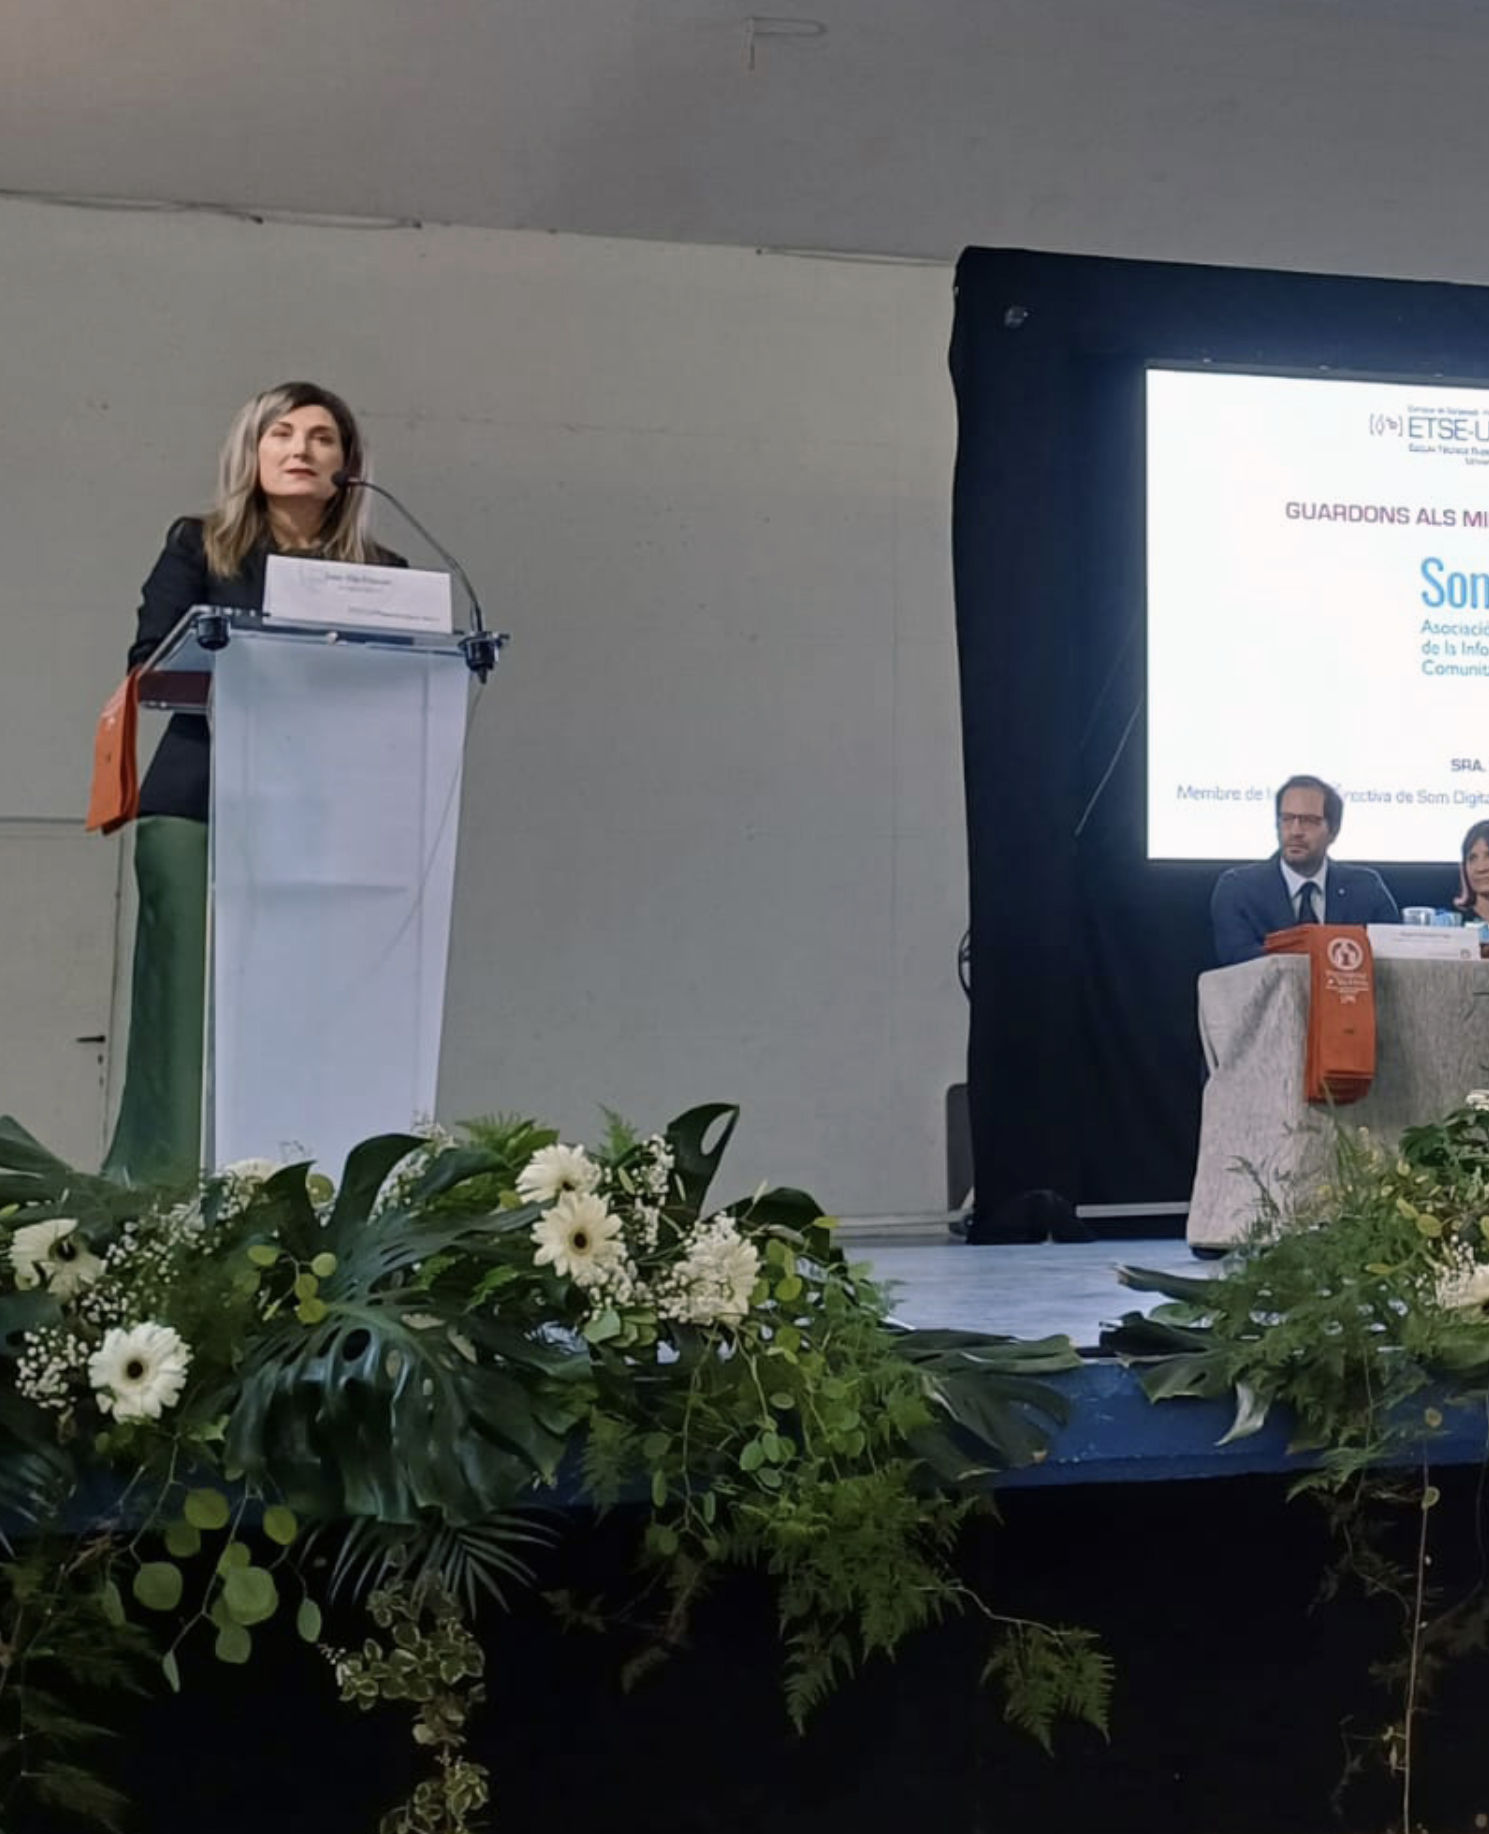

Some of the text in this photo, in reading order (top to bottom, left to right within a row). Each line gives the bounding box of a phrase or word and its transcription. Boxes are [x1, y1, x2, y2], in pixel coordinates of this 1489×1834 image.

[1286, 501, 1411, 525] GUARDONS
[1416, 507, 1457, 527] ALS
[1421, 640, 1440, 655] de
[1444, 640, 1457, 656] la
[1450, 758, 1485, 773] SRA.
[1176, 785, 1241, 801] Membre
[1245, 785, 1263, 801] de
[1396, 788, 1415, 804] de
[1417, 790, 1449, 805] Som
